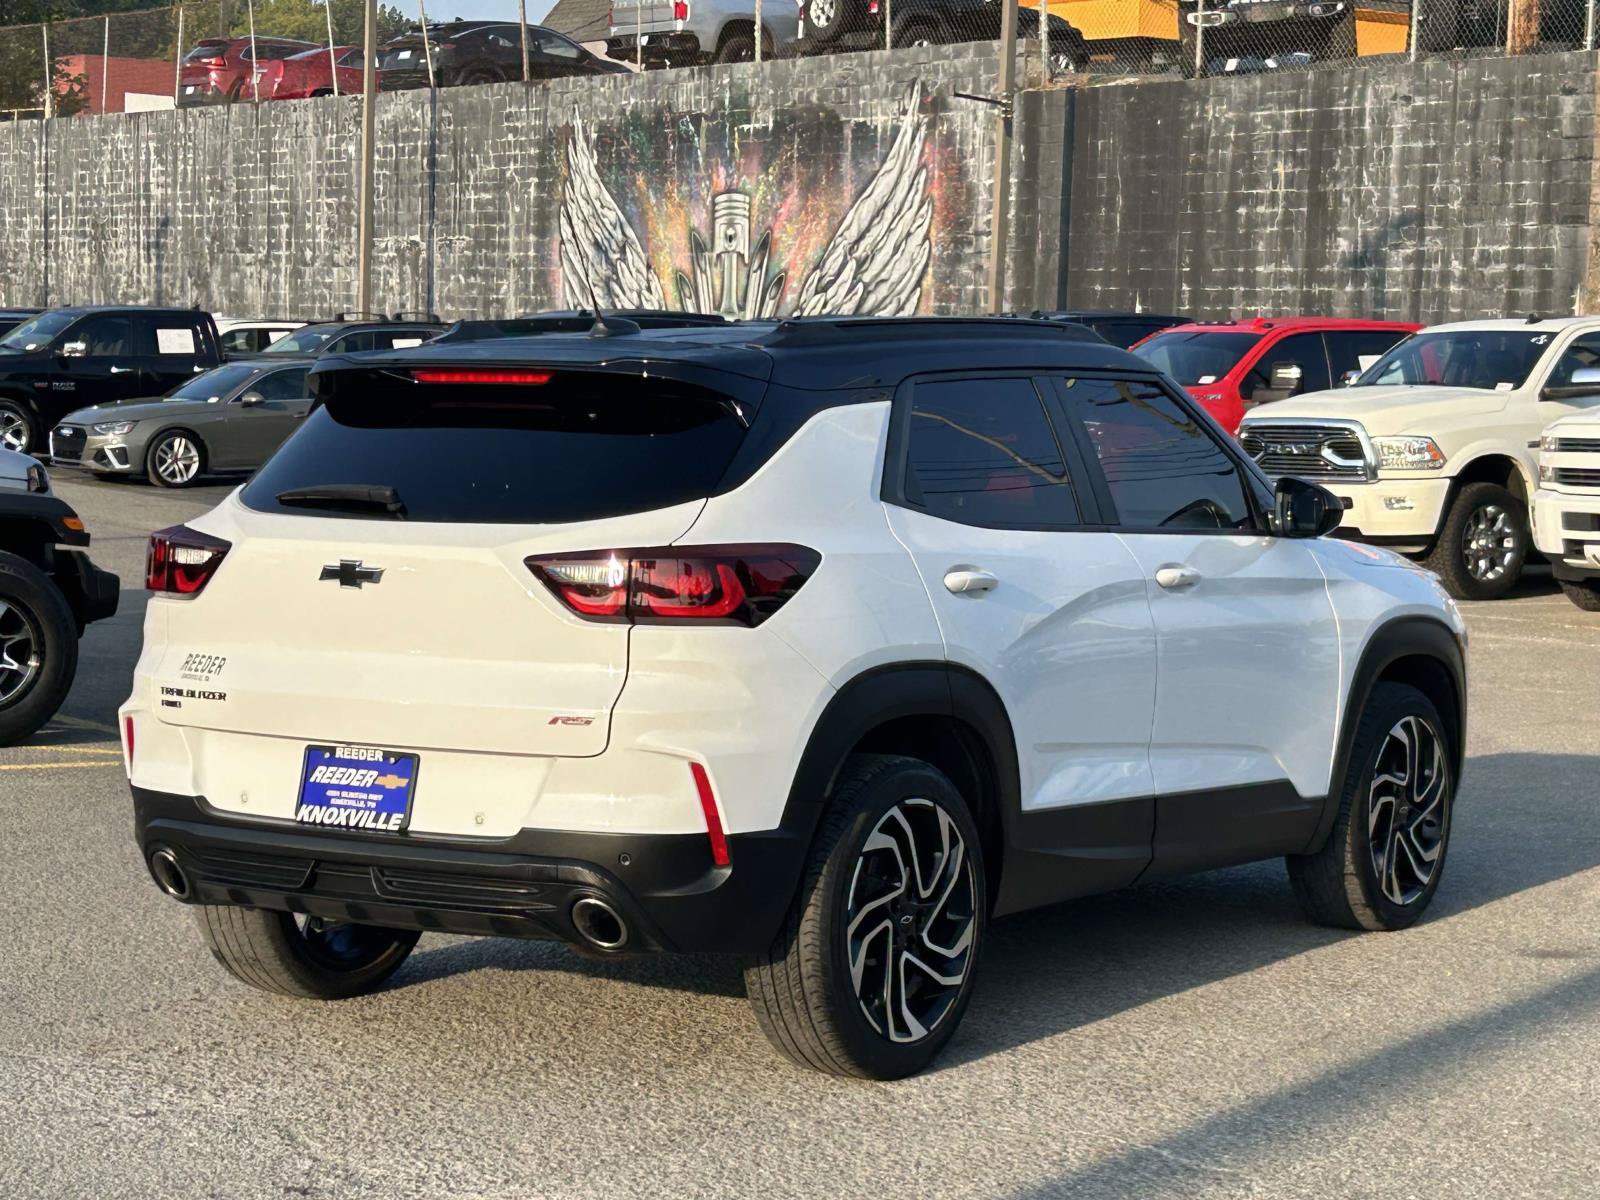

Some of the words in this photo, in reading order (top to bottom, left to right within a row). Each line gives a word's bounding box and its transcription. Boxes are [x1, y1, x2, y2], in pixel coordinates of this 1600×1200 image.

[181, 653, 226, 675] REEDER
[161, 687, 226, 700] TRAILBLAZER
[335, 747, 383, 761] REEDER
[310, 766, 378, 787] REEDER
[297, 805, 404, 830] KNOXVILLE
